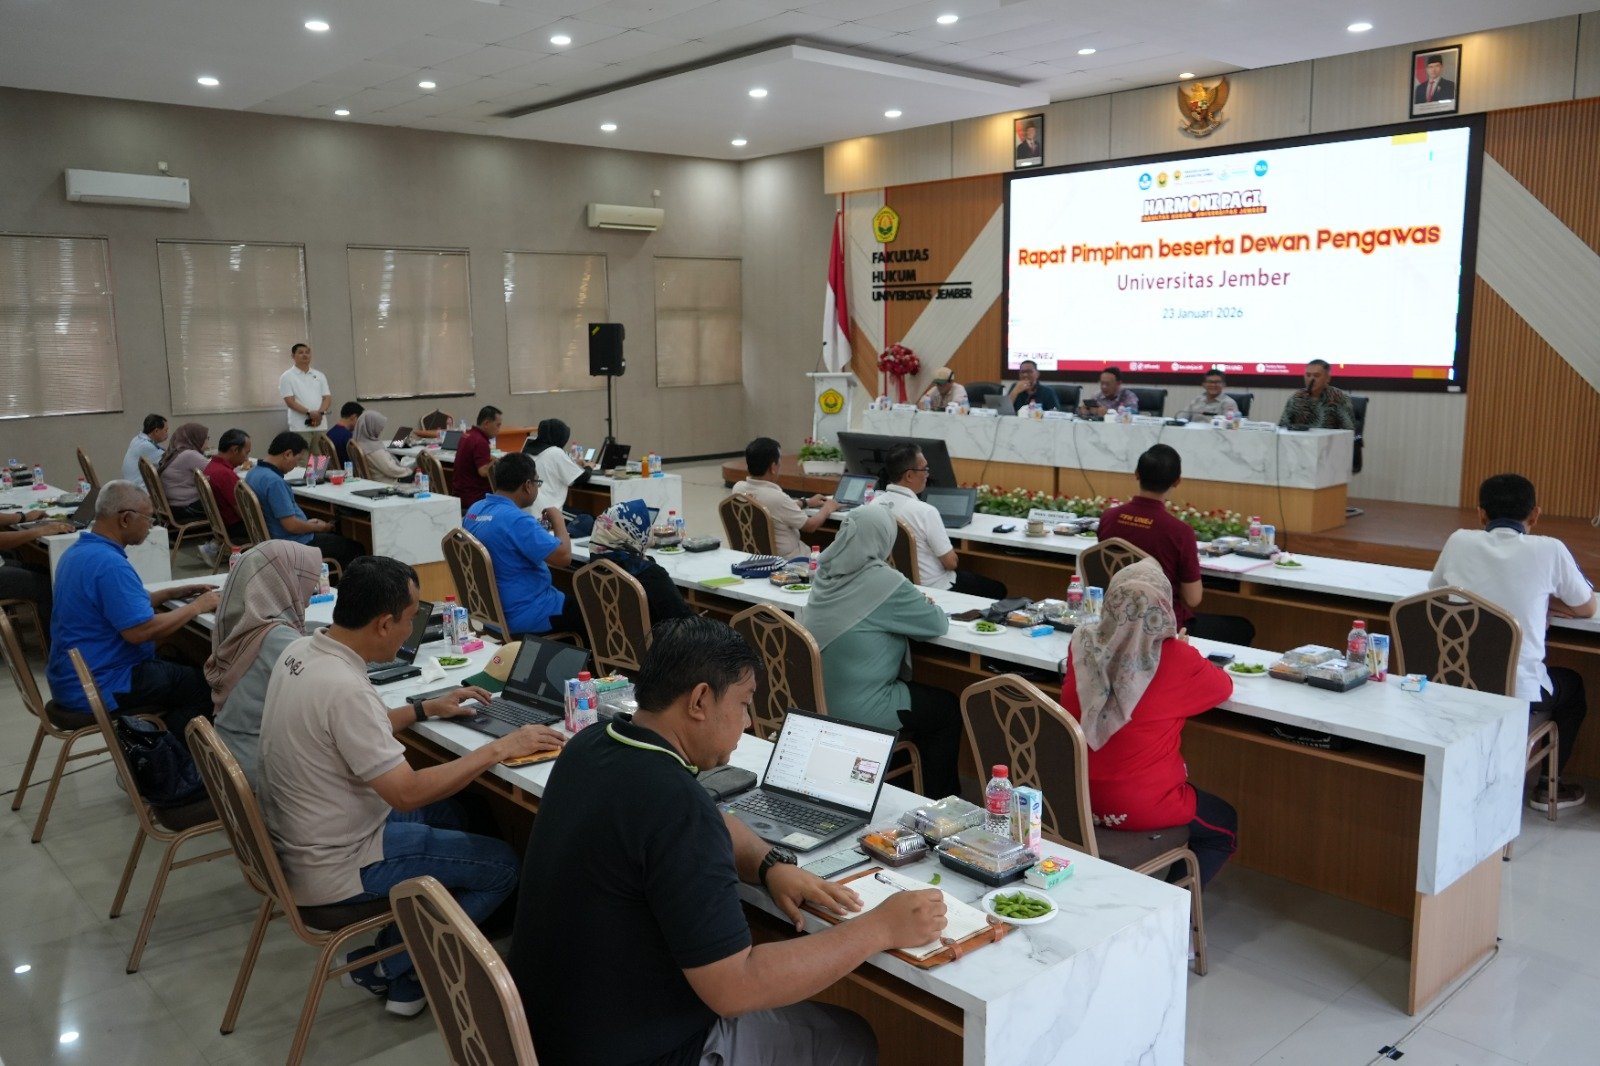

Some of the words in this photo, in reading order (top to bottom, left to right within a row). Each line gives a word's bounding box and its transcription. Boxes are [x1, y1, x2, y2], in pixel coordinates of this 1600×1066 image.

[1143, 192, 1220, 215] HARMONI
[1220, 189, 1262, 210] PAGI
[1018, 245, 1067, 269] Rapat
[1071, 242, 1154, 266] Pimpinan
[1158, 235, 1235, 258] beserta
[1240, 233, 1311, 254] Dewan
[1316, 224, 1441, 256] Pengawas
[872, 248, 930, 264] FAKULTAS
[872, 269, 917, 283] HUKUM
[1117, 271, 1214, 292] Universitas
[1219, 267, 1291, 288] Jember
[872, 289, 933, 302] UNIVERSITAS
[936, 288, 972, 300] JEMBER
[1162, 308, 1175, 319] 23
[1177, 307, 1214, 319] Januari
[1216, 306, 1244, 319] 2026
